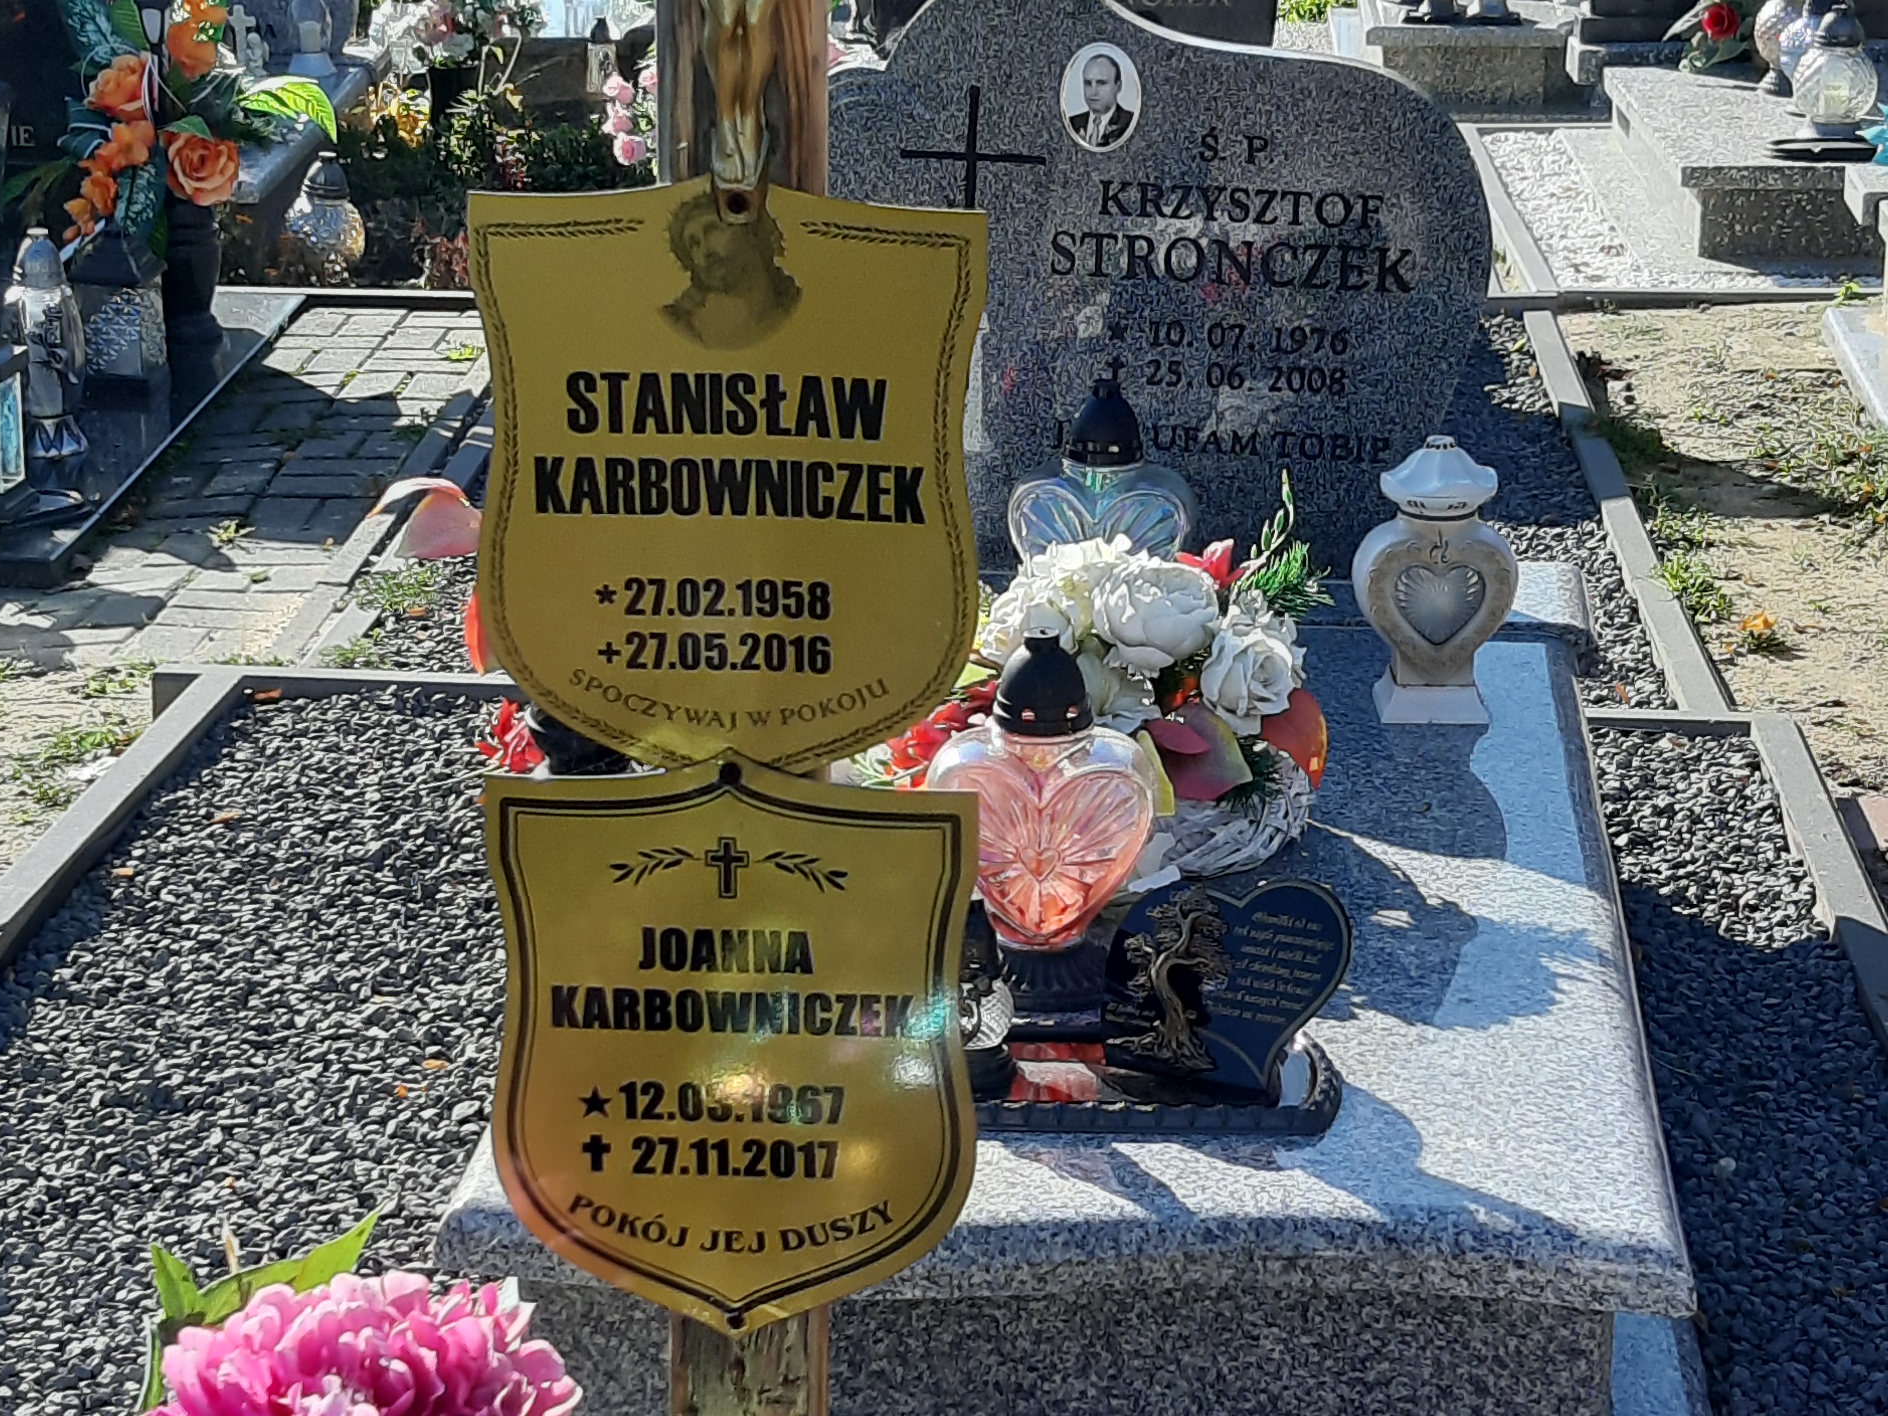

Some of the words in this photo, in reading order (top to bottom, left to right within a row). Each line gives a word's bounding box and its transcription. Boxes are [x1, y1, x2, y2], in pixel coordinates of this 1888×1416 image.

[1099, 179, 1384, 229] KRZYSZTOF
[565, 370, 888, 442] STANISŁAW
[1153, 424, 1260, 456] UFAM
[1262, 430, 1390, 462] TOBIE
[533, 455, 928, 526] KARBOWNICZEK
[567, 667, 739, 732] SPOCZYWAJ
[744, 709, 772, 728] W
[779, 676, 890, 727] POKOJU
[638, 926, 815, 975] JOANNA
[551, 984, 917, 1040] KARBOWNICZEK
[631, 1135, 840, 1180] 27.11.2017
[569, 1192, 690, 1249] POKÓJ
[699, 1229, 768, 1255] JEJ
[779, 1200, 895, 1255] DUSZY
